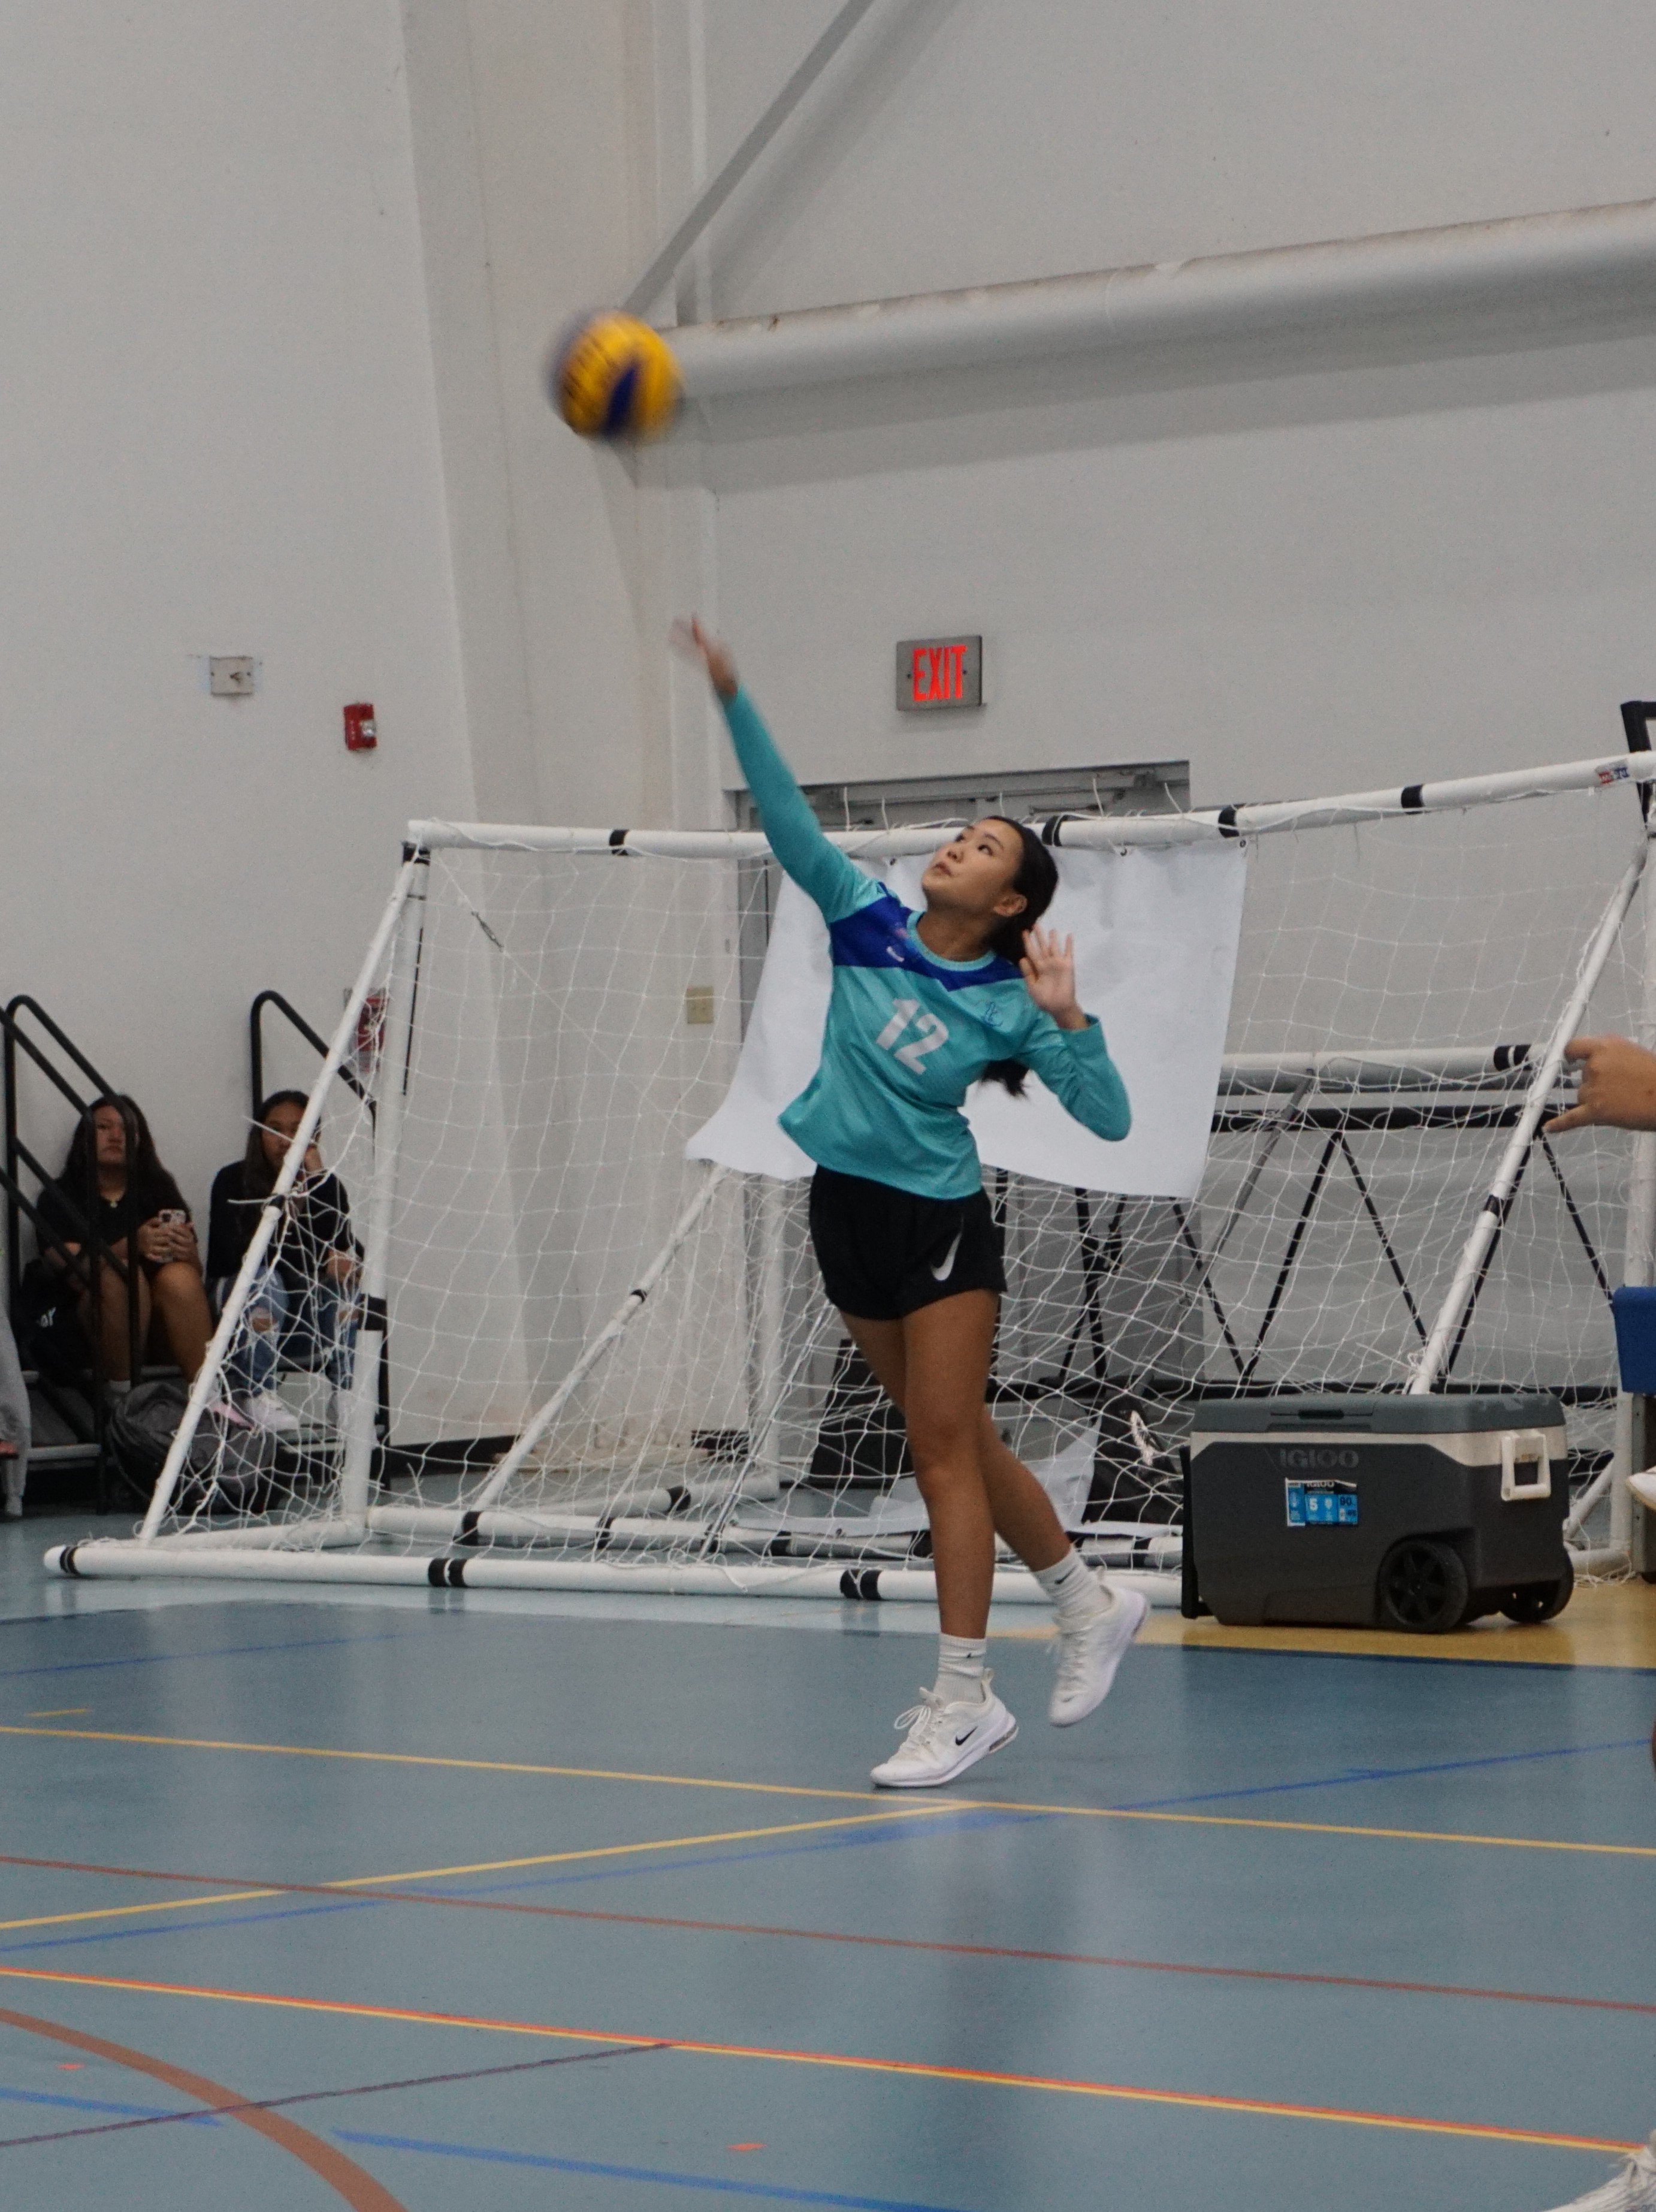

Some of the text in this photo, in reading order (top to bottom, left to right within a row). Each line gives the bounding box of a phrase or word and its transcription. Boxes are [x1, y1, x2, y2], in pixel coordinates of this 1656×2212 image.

[913, 644, 967, 701] EXIT
[876, 998, 949, 1075] 12
[1279, 1448, 1359, 1468] IGLOO
[1309, 1498, 1318, 1511] 5
